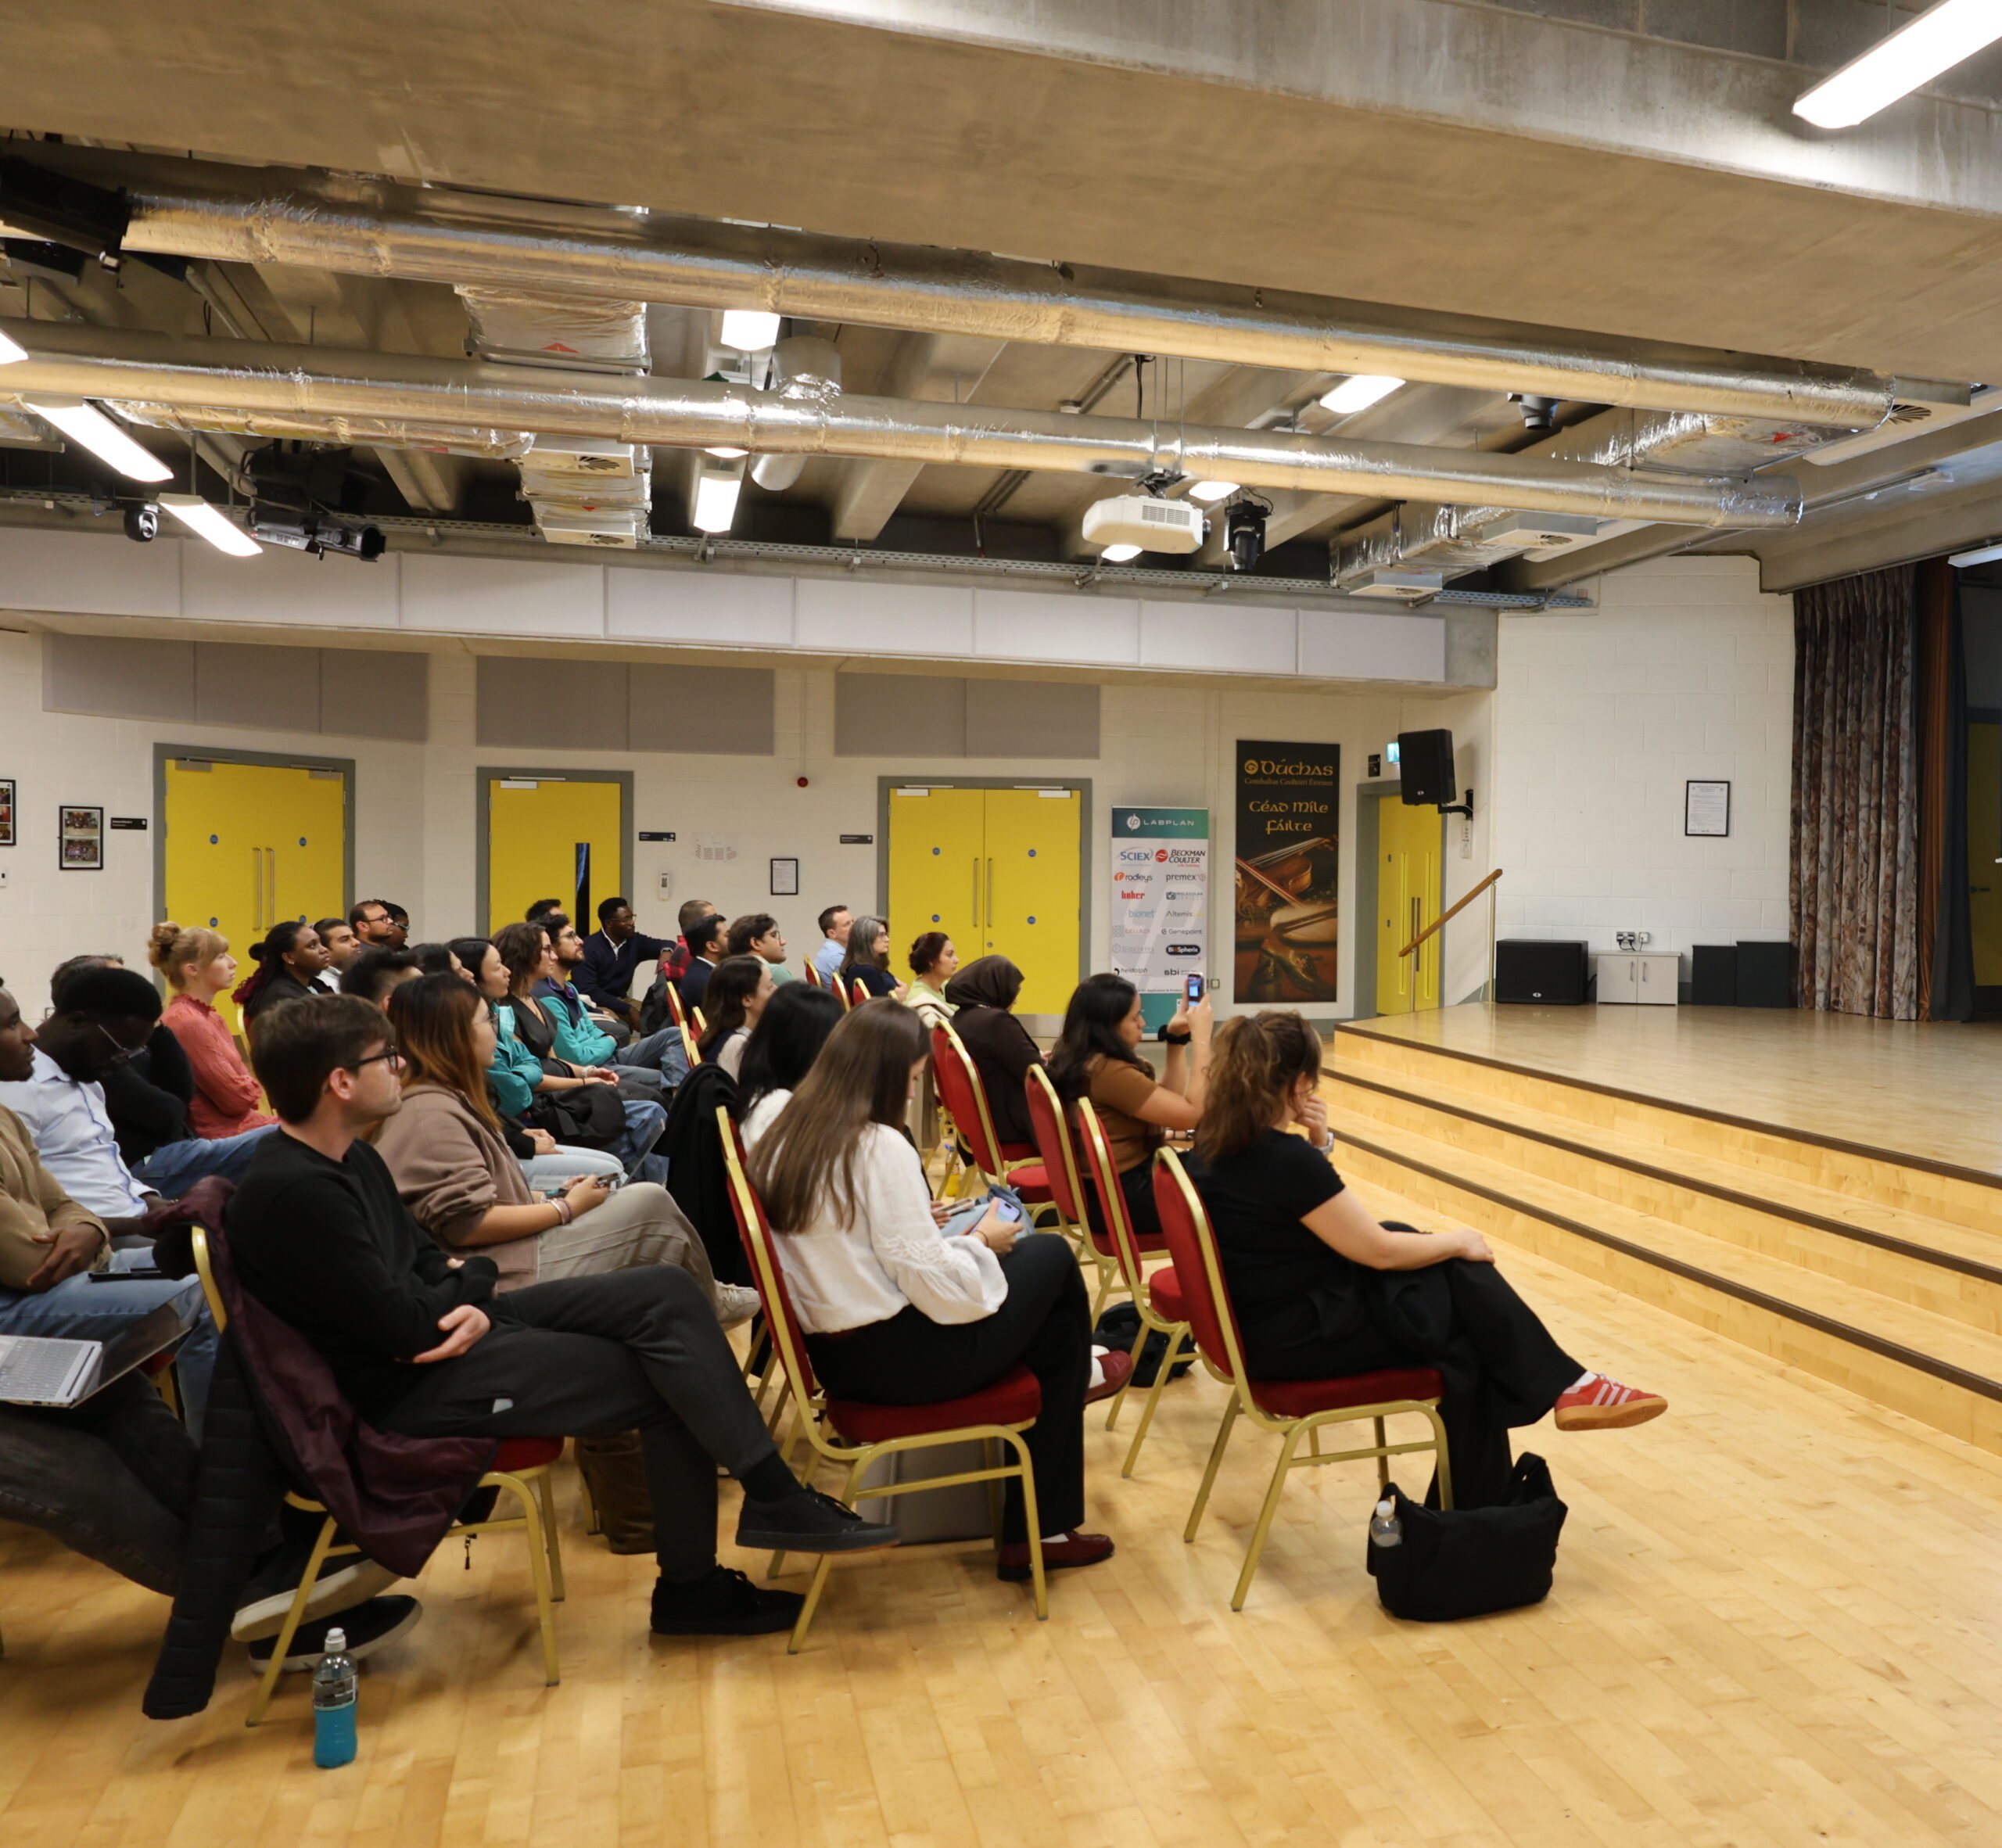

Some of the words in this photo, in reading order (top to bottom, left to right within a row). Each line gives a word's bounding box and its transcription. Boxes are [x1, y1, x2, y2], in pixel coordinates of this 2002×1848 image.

[1249, 799, 1289, 813] Céad
[1293, 800, 1329, 813] Míle
[1120, 851, 1150, 861] SCIEX
[1125, 872, 1153, 882] radleys
[1166, 874, 1197, 882] premex
